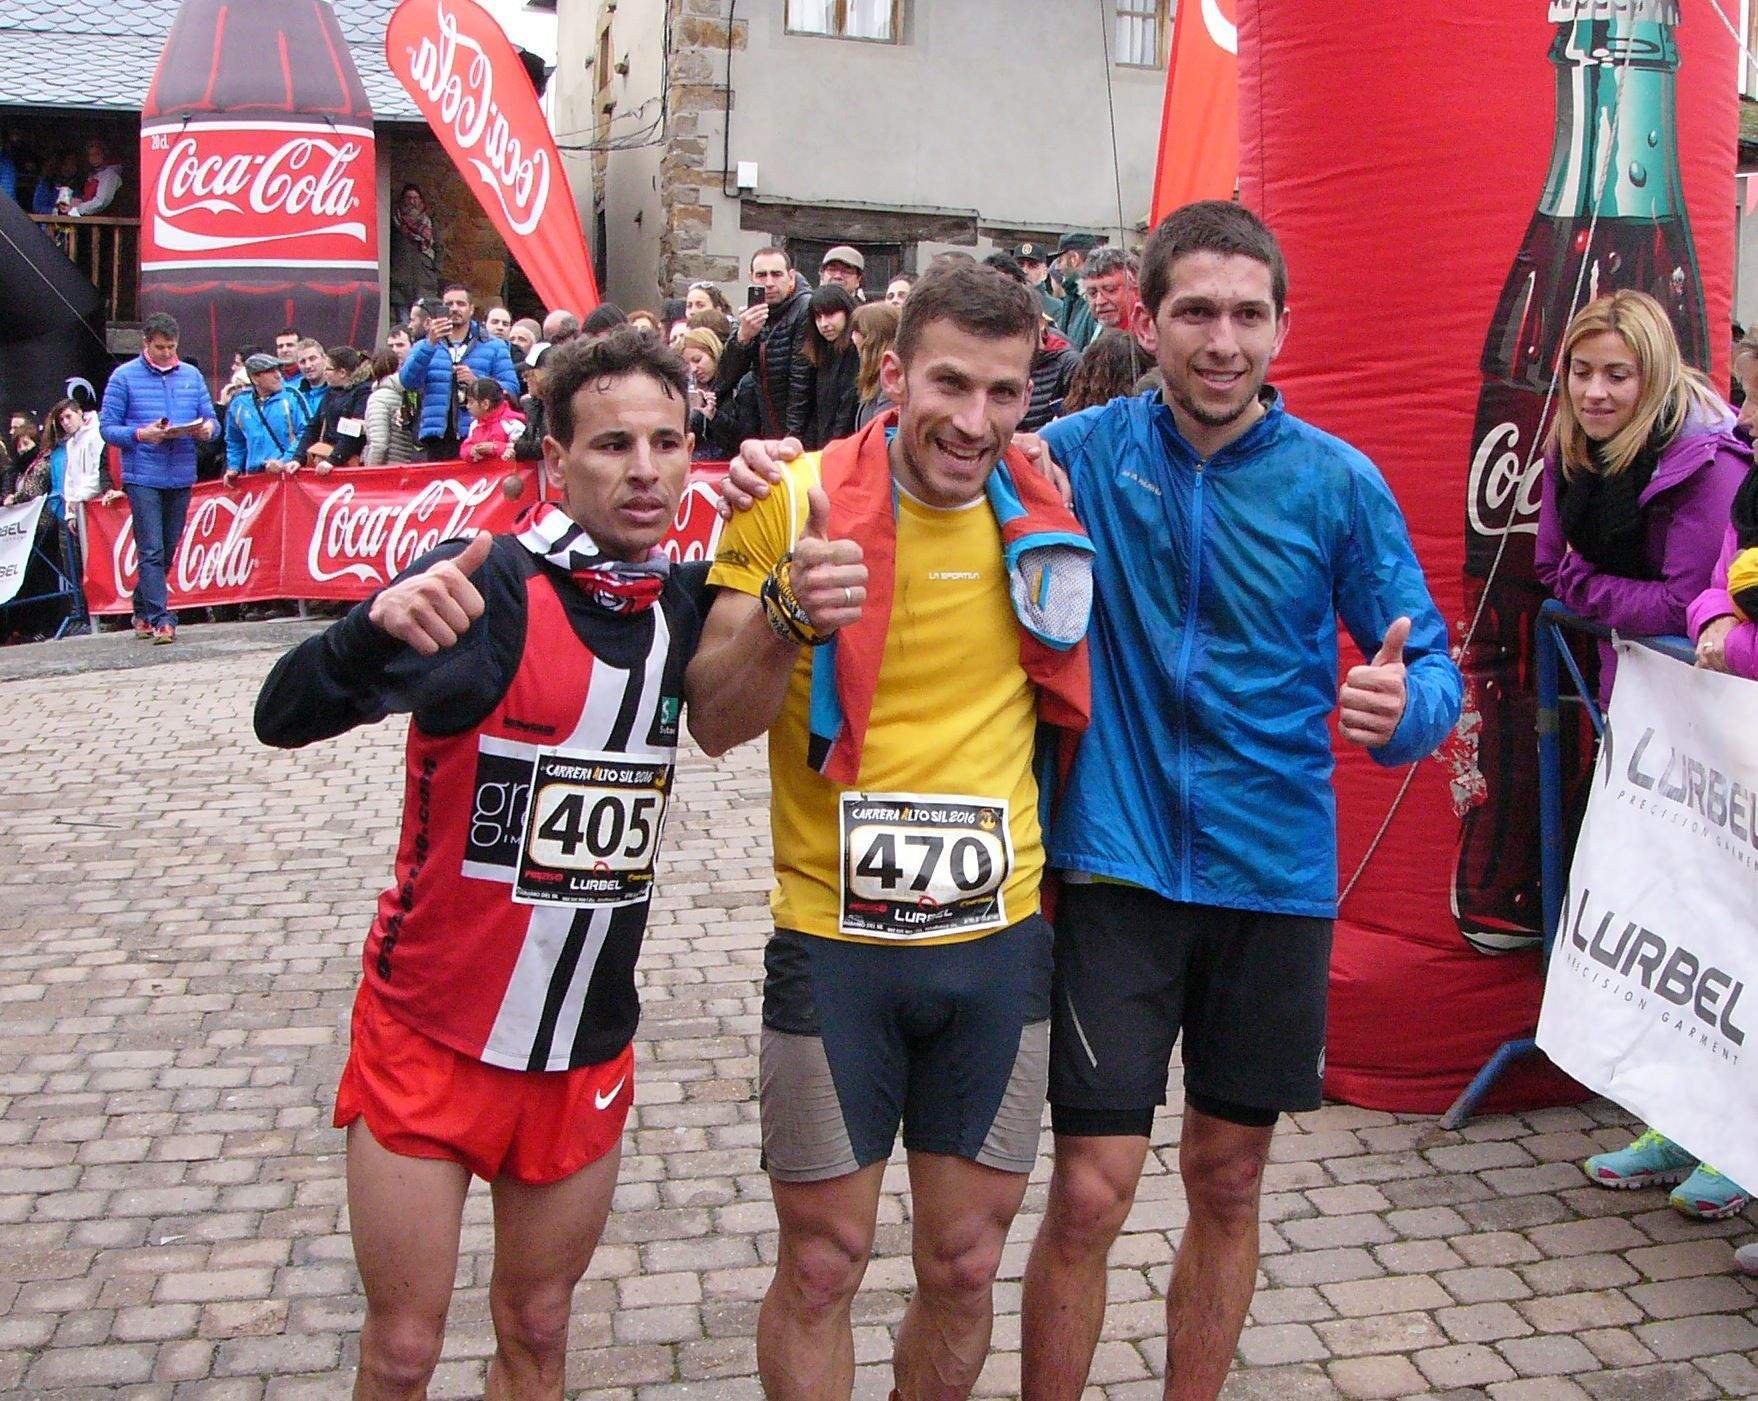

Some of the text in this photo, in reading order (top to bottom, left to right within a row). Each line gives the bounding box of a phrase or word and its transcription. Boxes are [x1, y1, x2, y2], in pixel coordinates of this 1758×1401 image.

[157, 138, 362, 217] Coca-Cola
[471, 782, 530, 847] gr
[538, 794, 656, 858] 405
[852, 806, 977, 825] CARRERA ALTO SIL 2016
[856, 833, 992, 891] 470
[1572, 889, 1746, 1047] LURBEL
[1661, 1011, 1739, 1066] GARMENT
